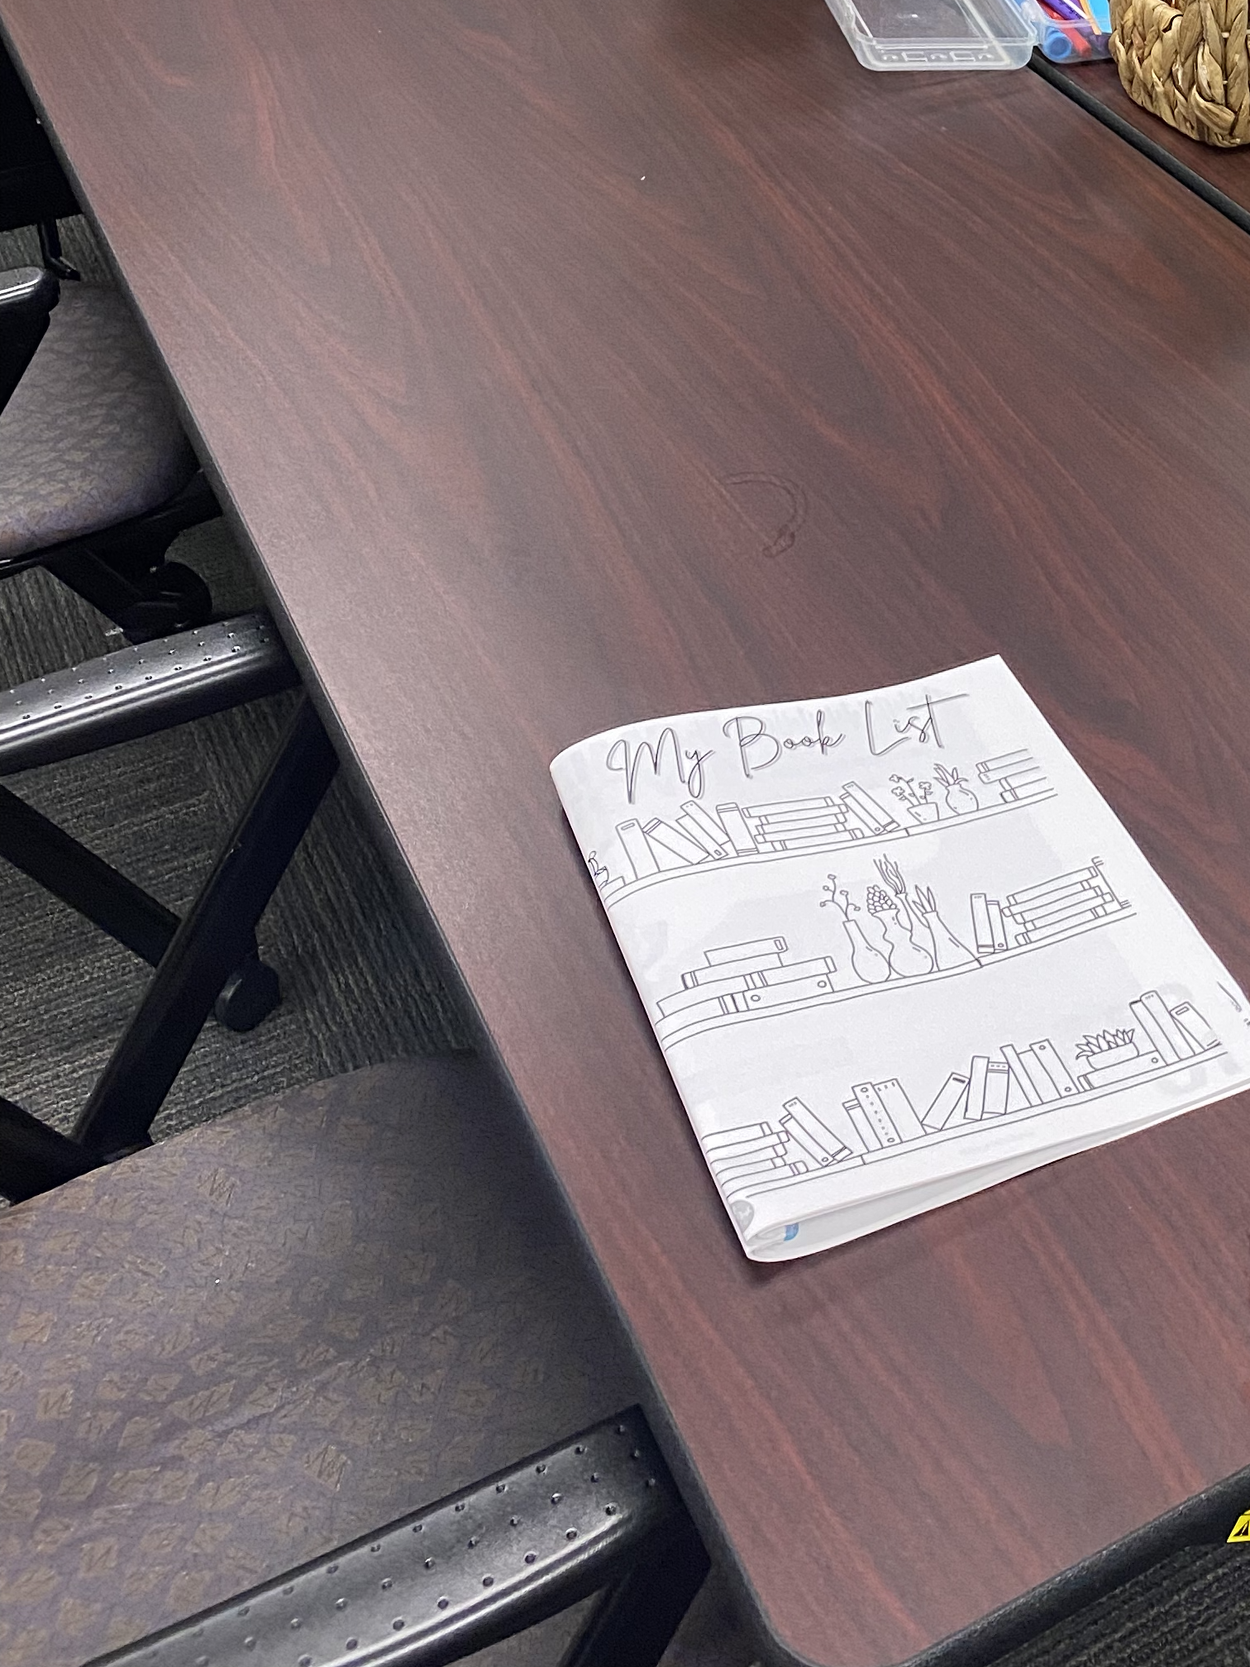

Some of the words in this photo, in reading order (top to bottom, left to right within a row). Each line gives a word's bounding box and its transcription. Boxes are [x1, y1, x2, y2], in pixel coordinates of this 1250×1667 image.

[606, 727, 716, 804] My
[722, 709, 846, 780] Book
[864, 693, 970, 757] List
